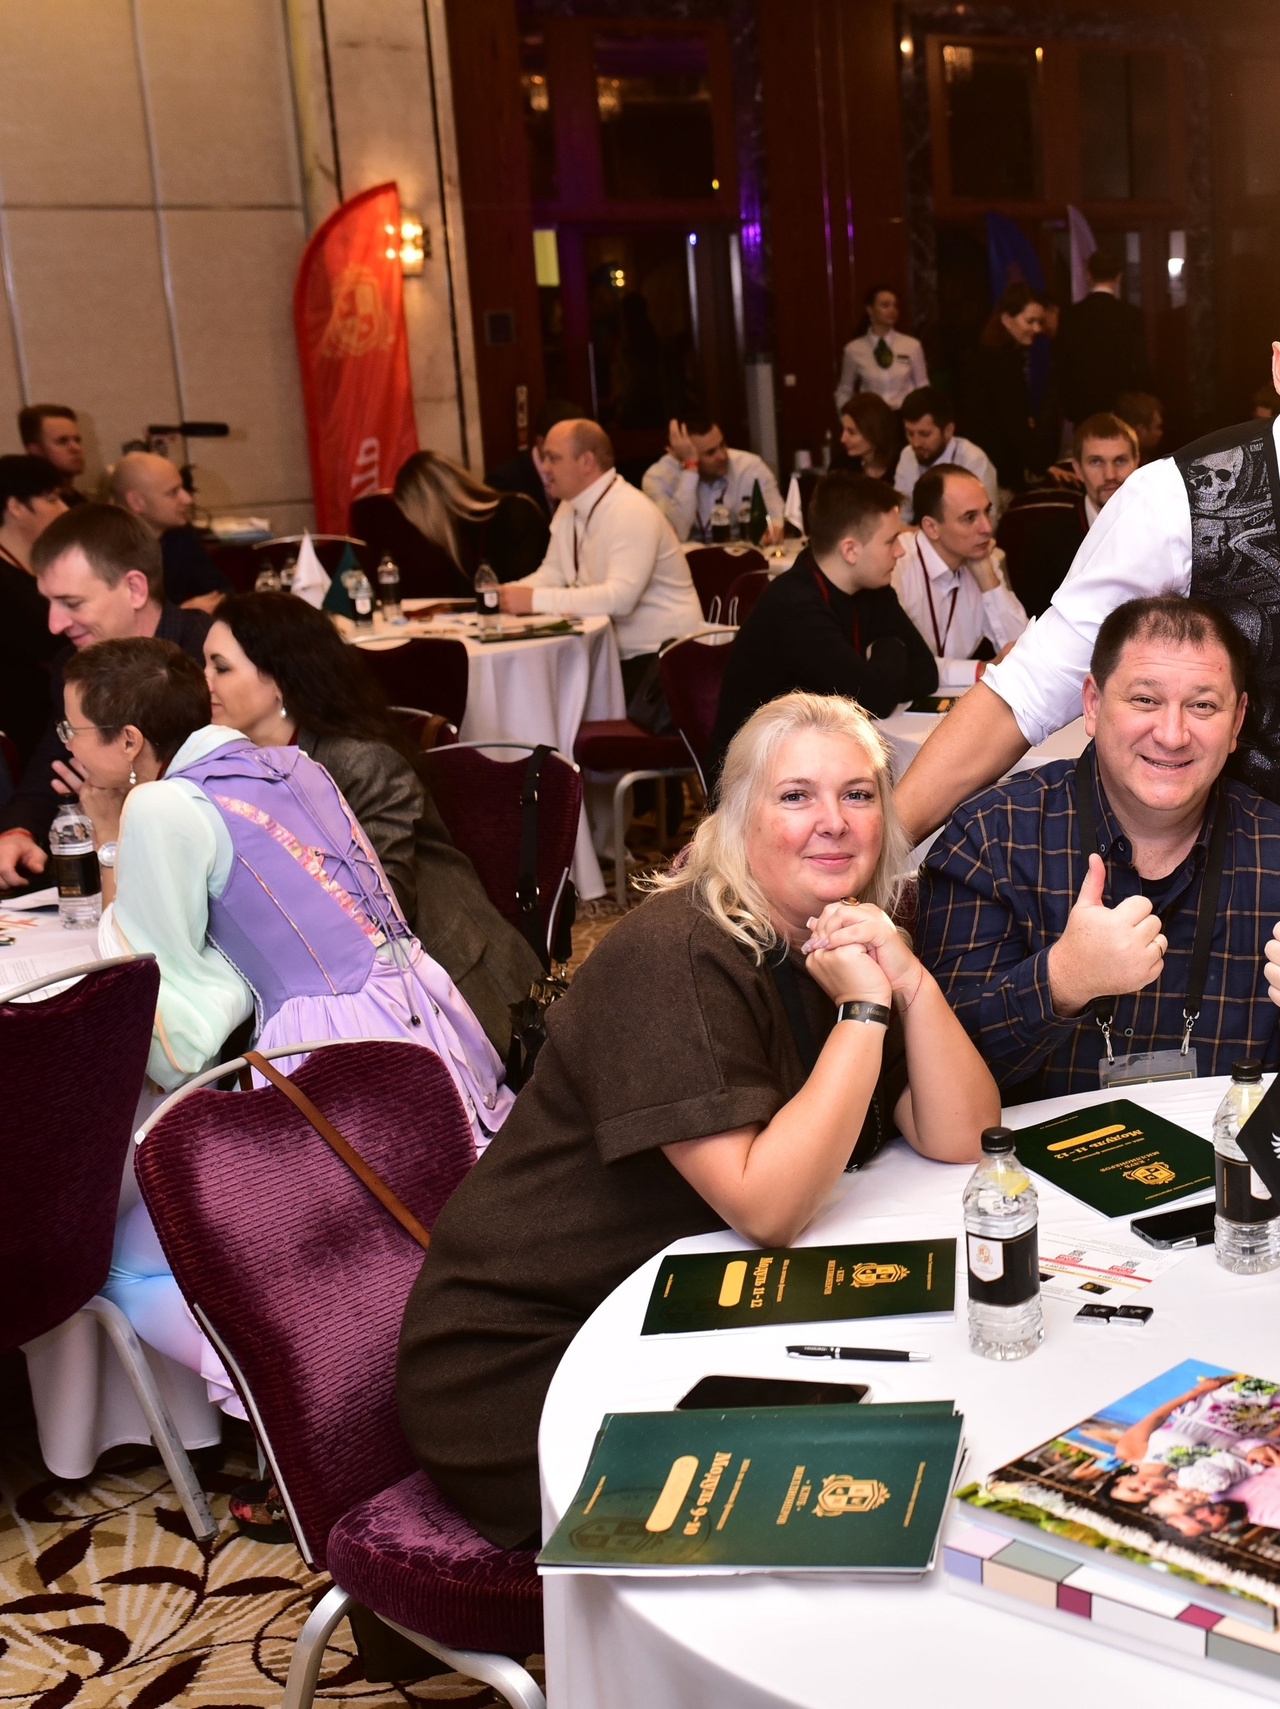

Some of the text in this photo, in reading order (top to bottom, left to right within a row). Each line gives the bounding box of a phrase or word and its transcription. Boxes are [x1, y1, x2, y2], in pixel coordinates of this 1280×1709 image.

[1089, 1129, 1143, 1149] Модуль
[750, 1256, 773, 1308] Модуль 11-12
[683, 1452, 732, 1535] Модуль 9-10
